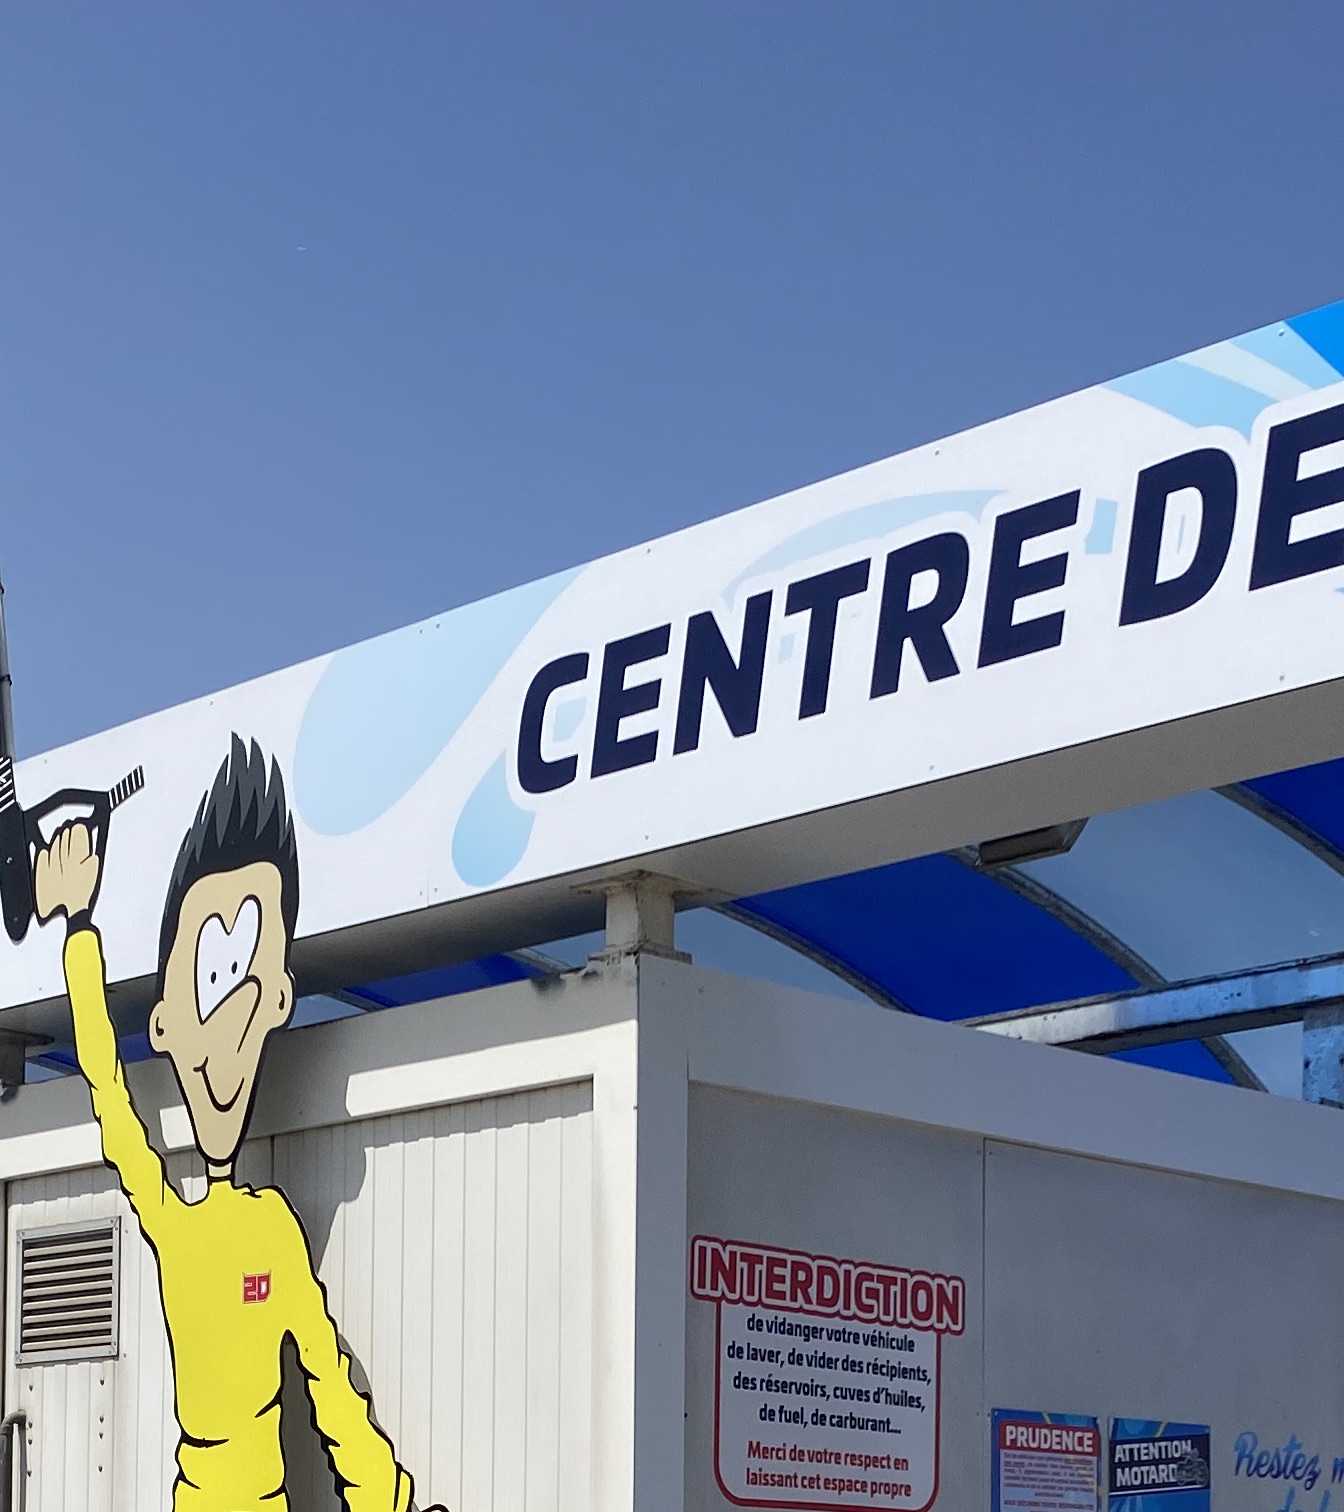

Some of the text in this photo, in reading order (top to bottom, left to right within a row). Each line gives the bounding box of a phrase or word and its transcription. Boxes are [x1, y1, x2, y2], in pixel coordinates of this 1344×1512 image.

[517, 489, 1082, 794] CENTRE
[696, 1244, 960, 1326] INTERDICTION
[747, 1313, 915, 1352] de vidanger votre véhicule
[727, 1341, 932, 1386] de laver, de vider des récipients,
[733, 1371, 926, 1413] des réservoirs, cuves d'huiles,
[759, 1403, 902, 1434] de fuel, de carburant...
[747, 1440, 909, 1471] Merci de votre respect en
[1005, 1425, 1094, 1453] PRUDENCE
[1114, 1439, 1192, 1463] ATTENTION
[1234, 1431, 1322, 1491] Restez
[746, 1467, 912, 1500] laissant cet espace propre
